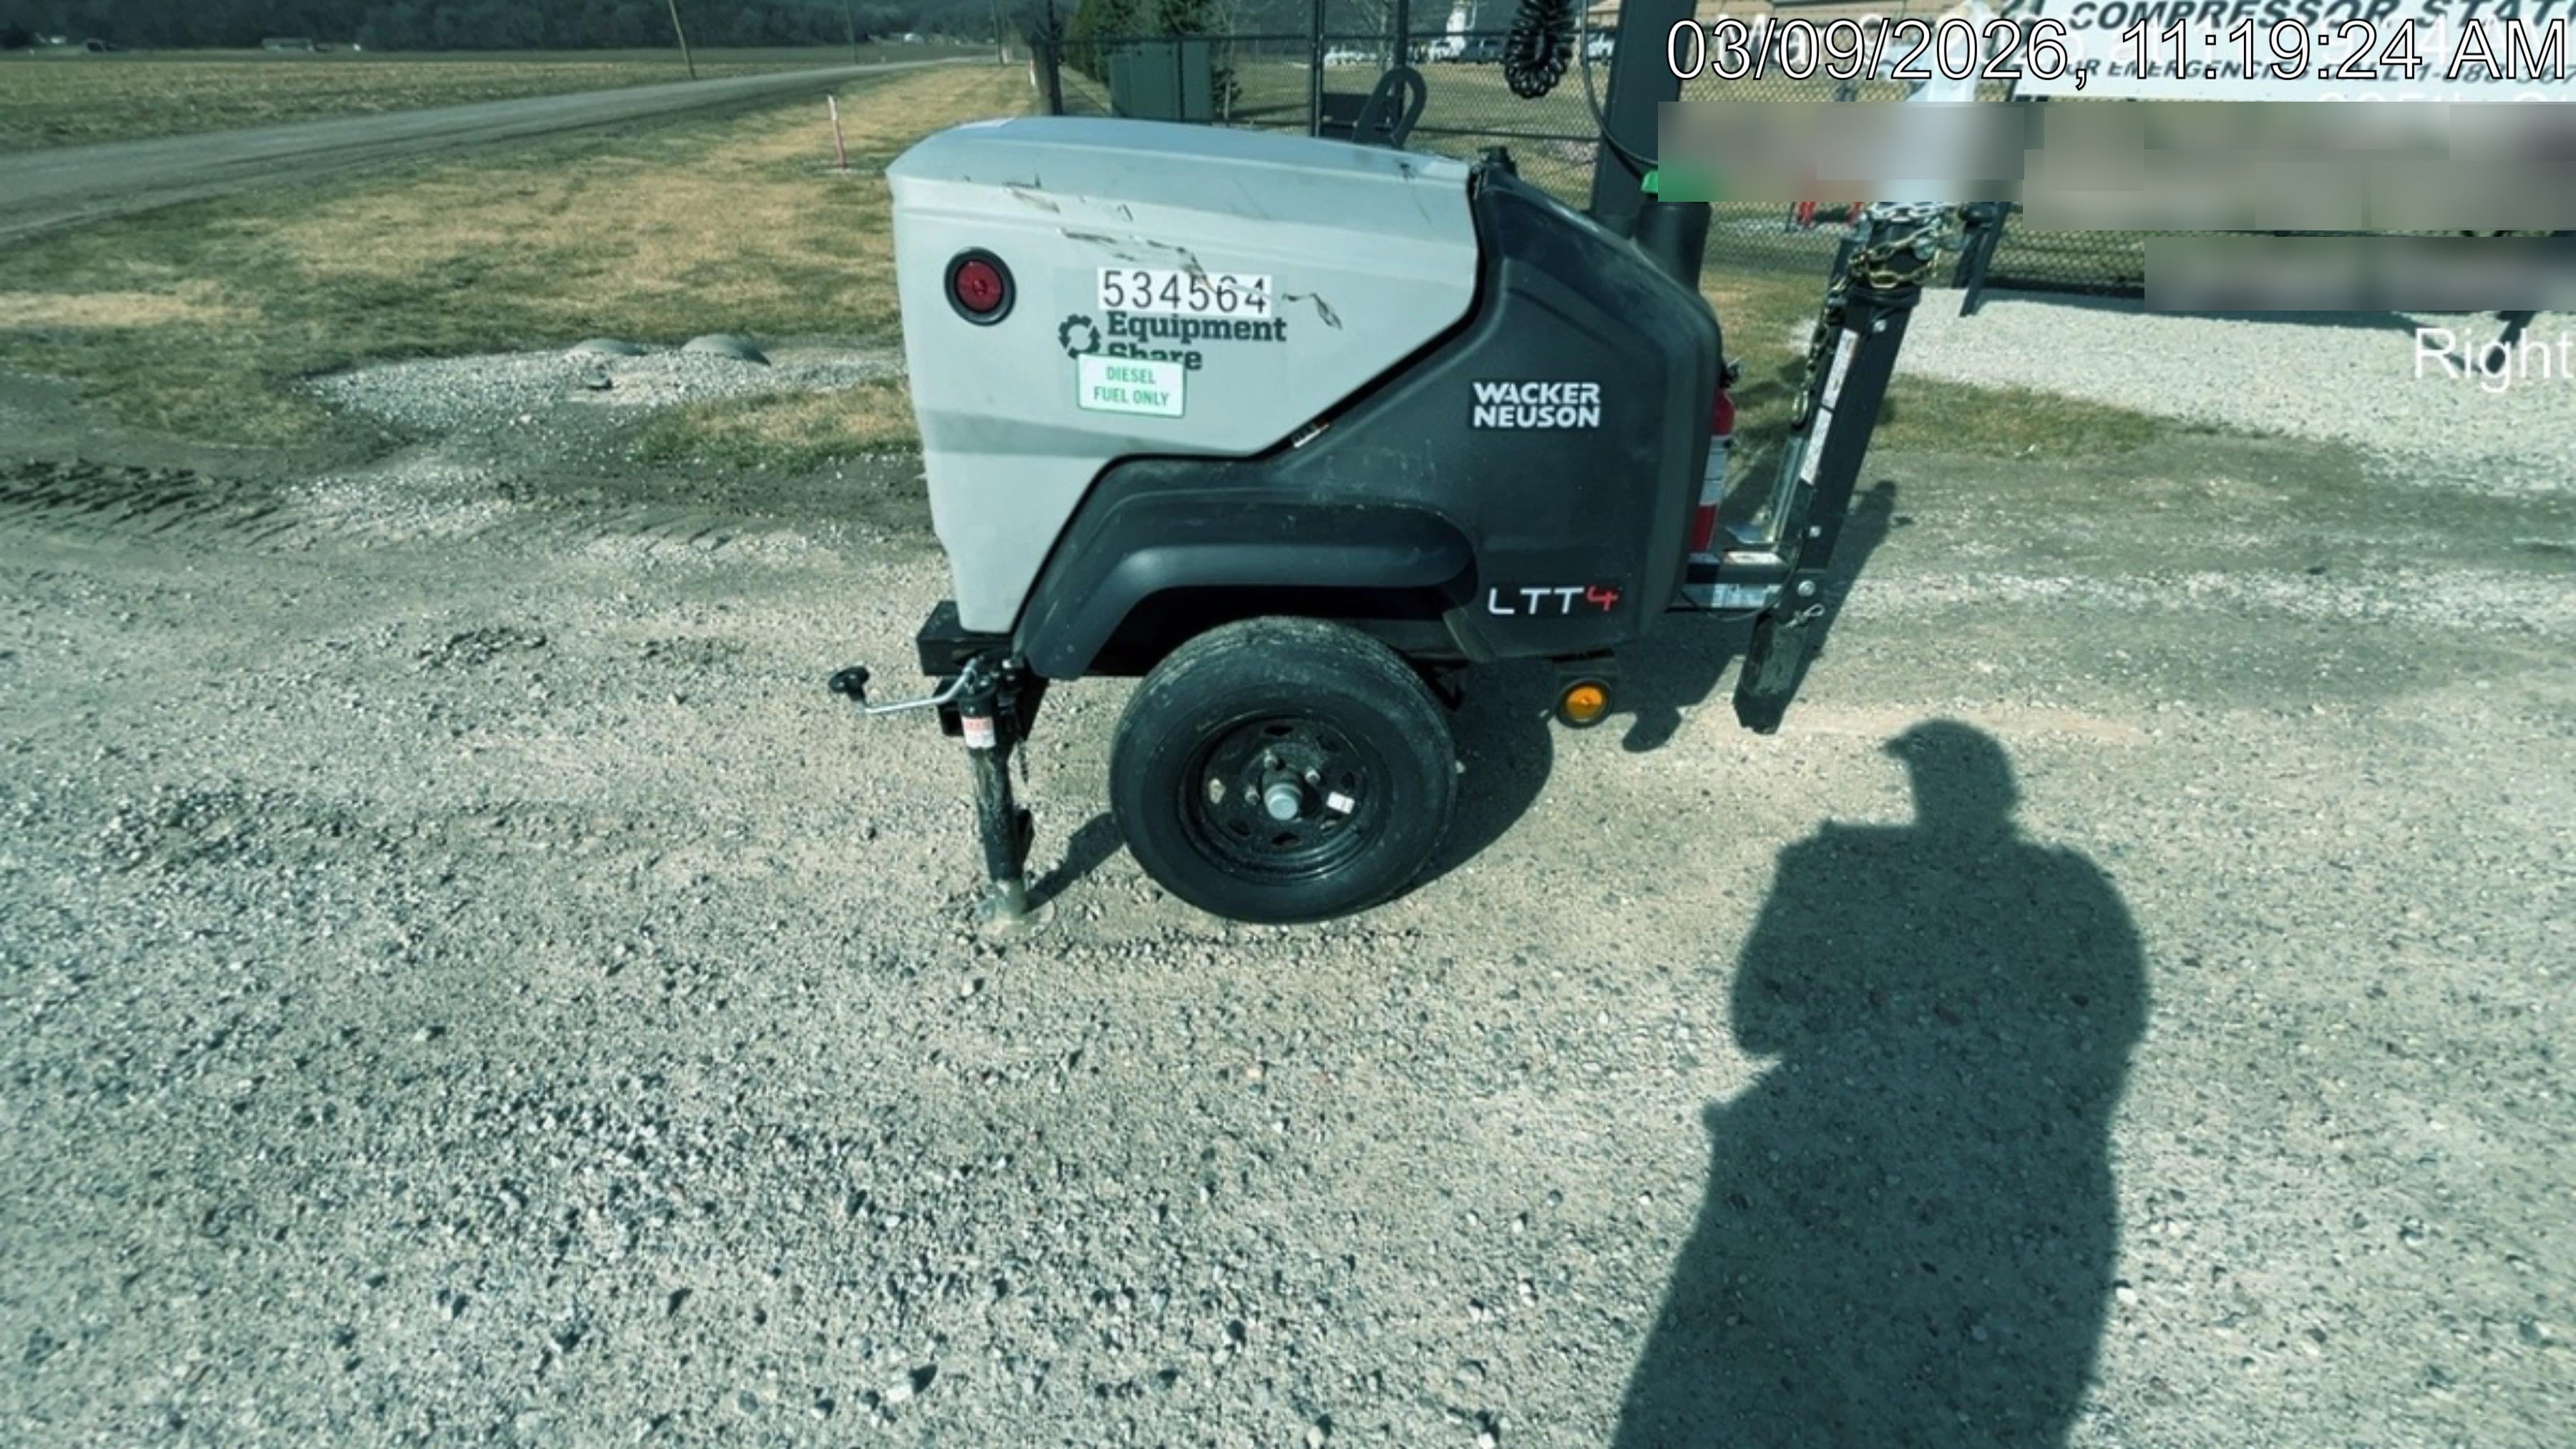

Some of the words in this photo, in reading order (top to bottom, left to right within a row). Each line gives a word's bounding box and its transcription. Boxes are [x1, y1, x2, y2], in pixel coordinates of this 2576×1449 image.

[1103, 269, 1267, 314] 534564
[1106, 310, 1287, 345] Equipment
[1106, 366, 1157, 385] DIESEL
[1093, 386, 1129, 404] FUEL
[1133, 389, 1171, 406] ONLY
[1473, 381, 1601, 405] WACKER
[1473, 405, 1601, 428] NEUSON
